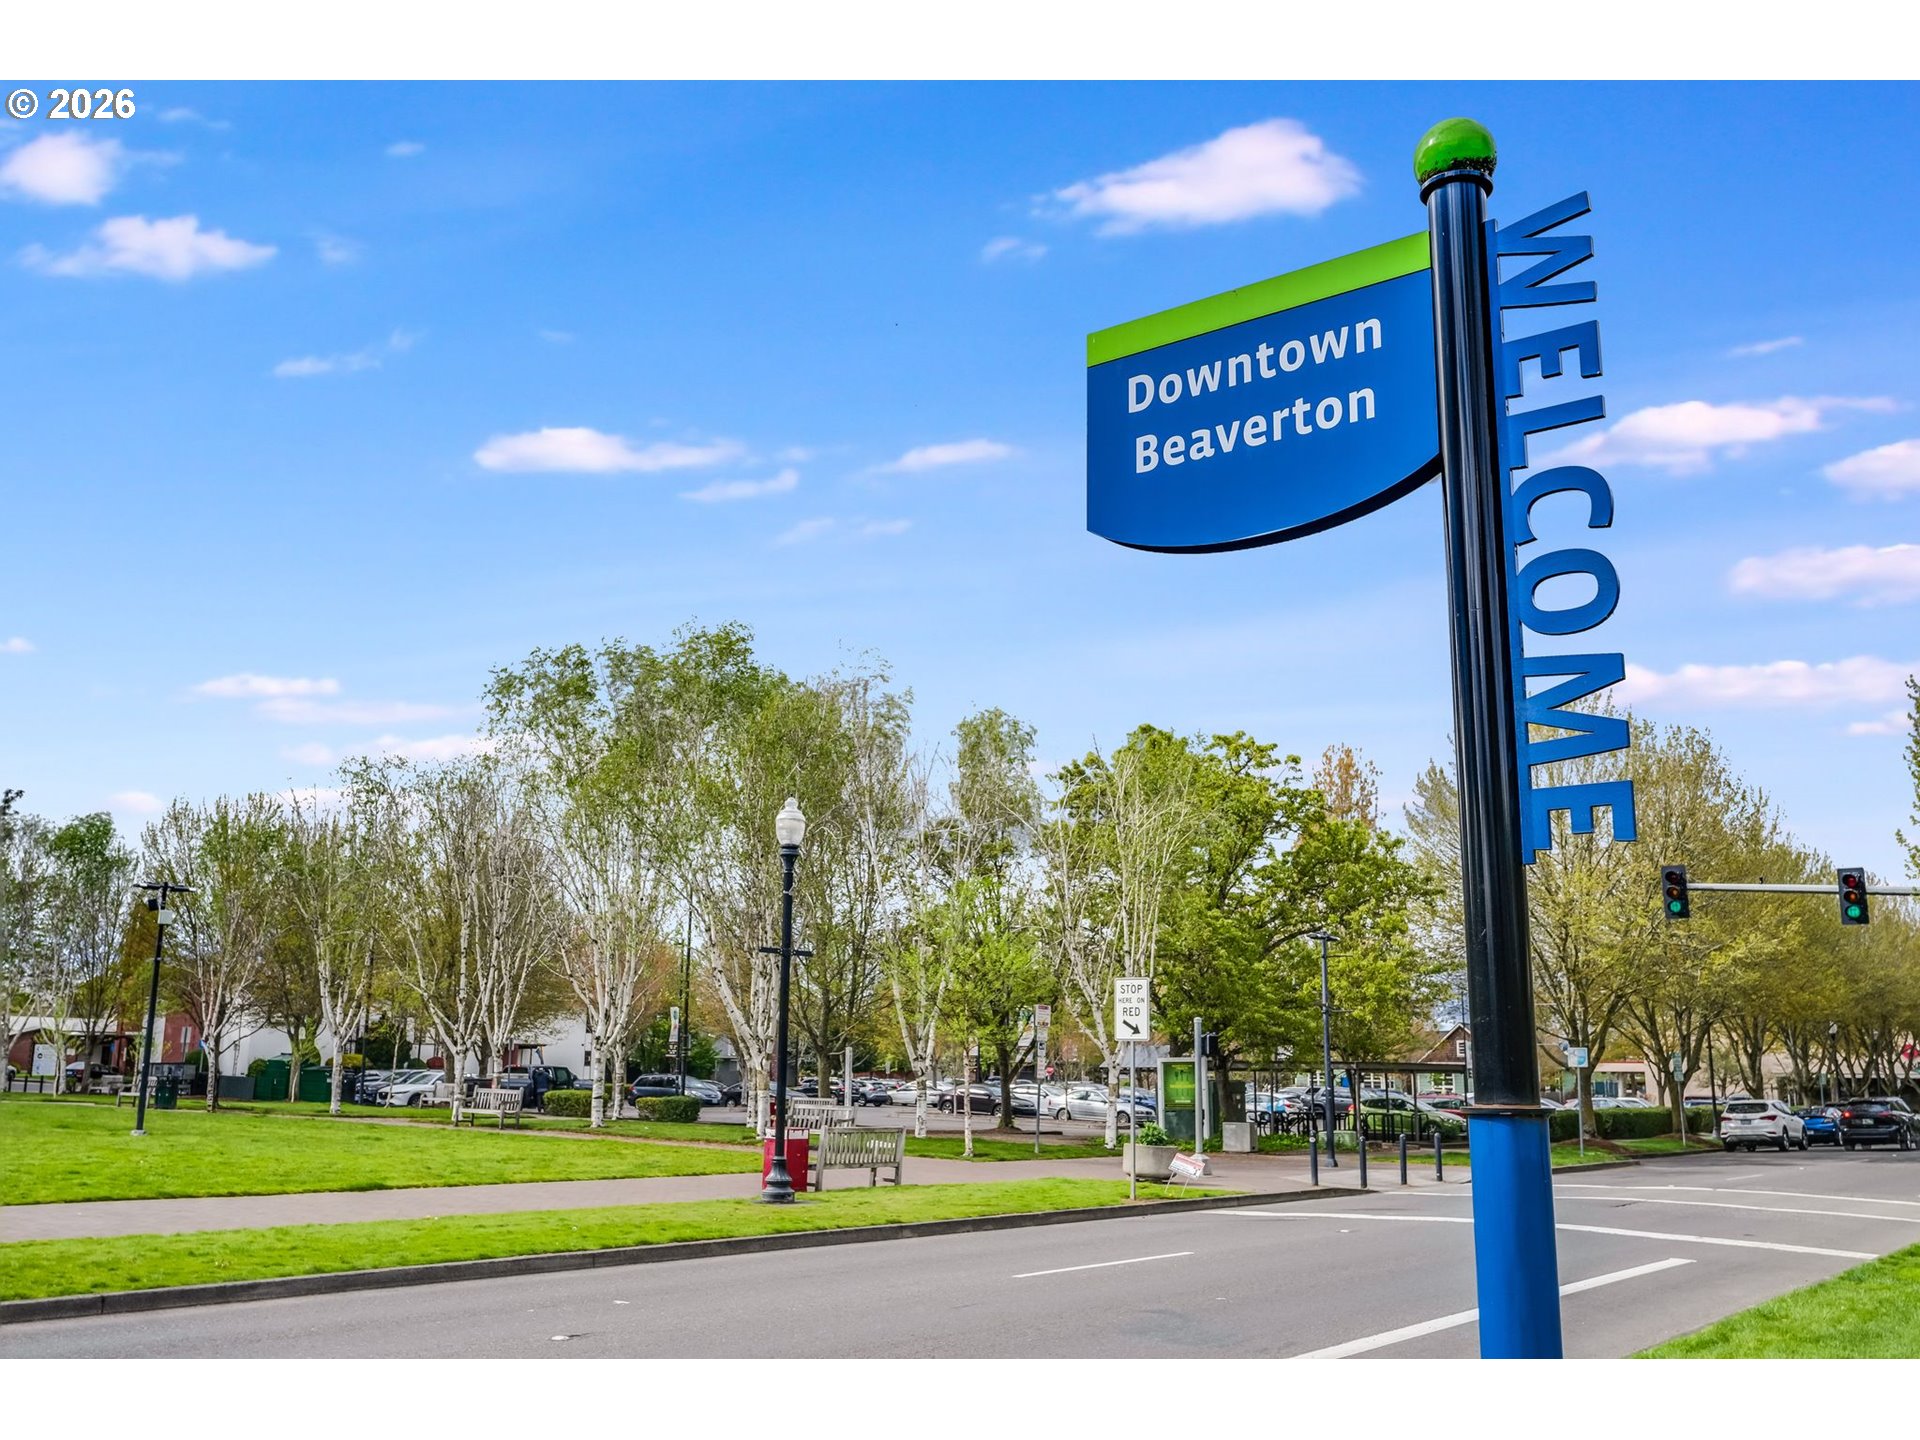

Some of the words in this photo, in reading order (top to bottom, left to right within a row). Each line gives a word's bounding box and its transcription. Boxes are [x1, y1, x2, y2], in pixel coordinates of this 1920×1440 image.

[1127, 317, 1383, 414] Downtown
[1134, 386, 1377, 475] Beaverton
[1496, 190, 1638, 851] WELCOME
[1120, 984, 1143, 995] STOP
[1122, 1006, 1142, 1017] RED
